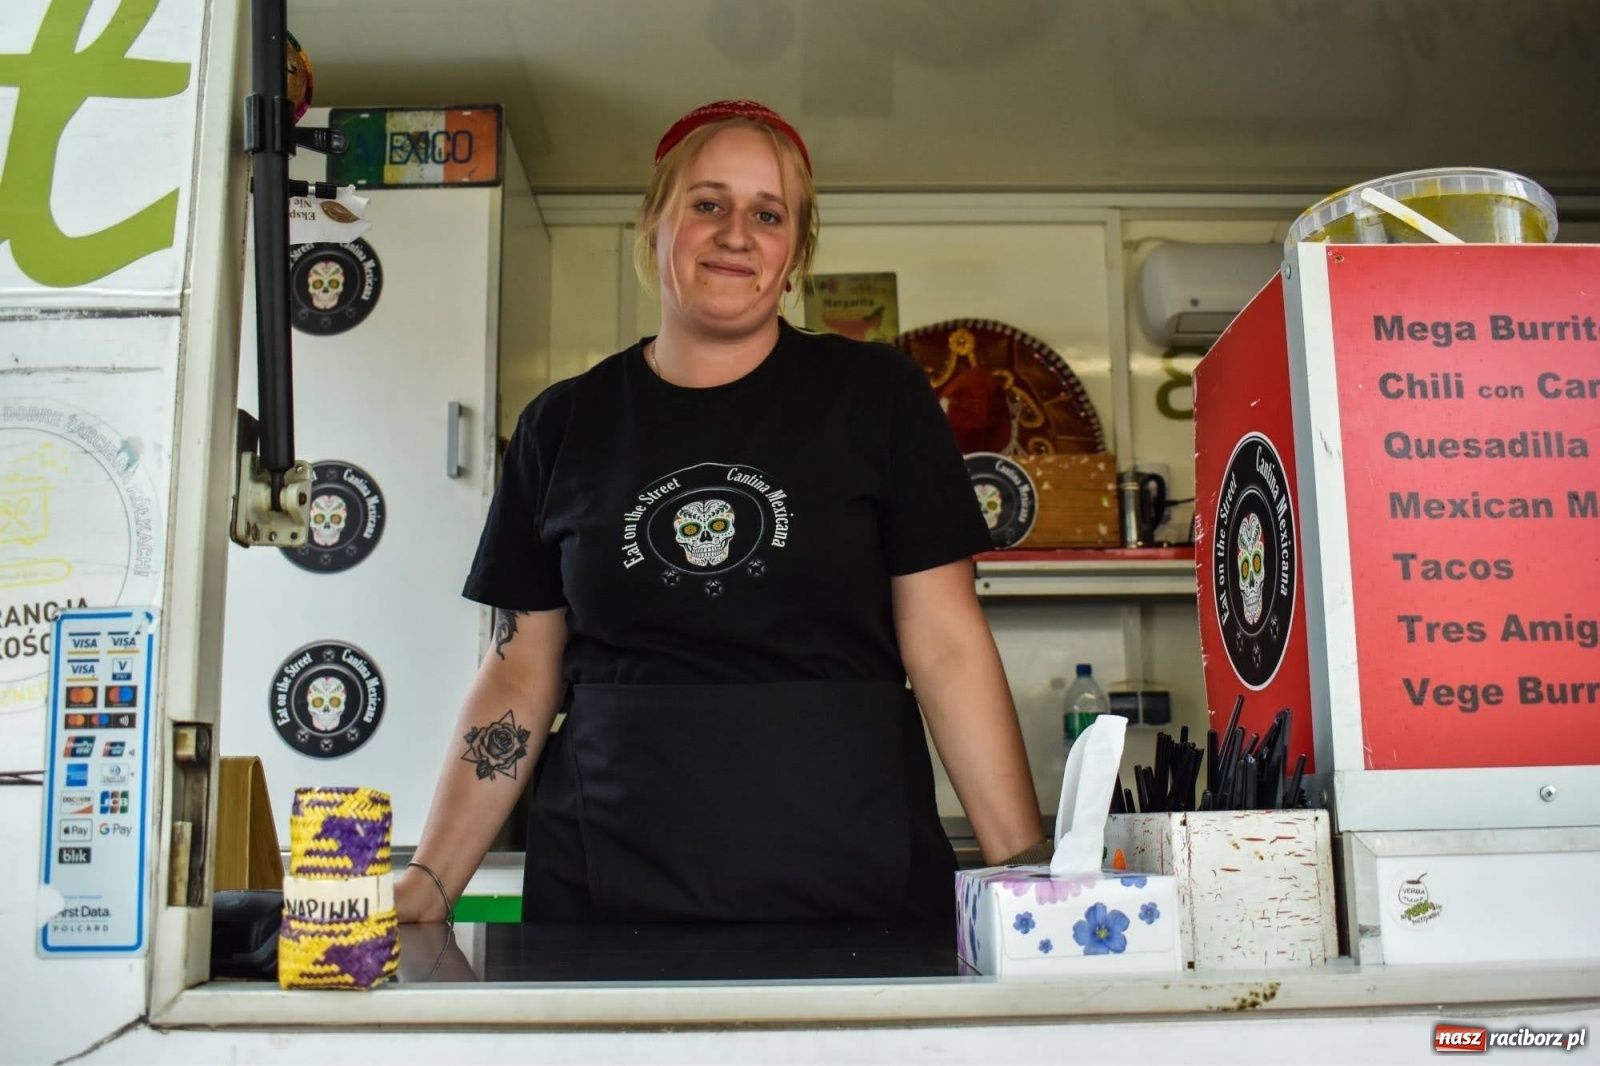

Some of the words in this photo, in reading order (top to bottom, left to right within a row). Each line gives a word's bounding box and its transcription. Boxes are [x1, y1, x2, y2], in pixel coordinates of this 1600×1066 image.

[1373, 315, 1477, 348] Mega
[1489, 314, 1600, 342] Burrit
[1378, 372, 1465, 400] Chili
[1478, 385, 1525, 399] con
[1384, 431, 1590, 460] Quesadilla
[343, 468, 371, 497] Cantina
[638, 477, 681, 505] Street
[726, 467, 770, 493] Cantina
[765, 489, 794, 548] Mexicana
[1220, 471, 1237, 525] Street
[1389, 491, 1553, 519] Mexican
[1567, 490, 1599, 519] M
[624, 505, 647, 522] the
[1256, 445, 1279, 502] Cantina
[1276, 493, 1291, 597] Mexicana
[623, 523, 637, 540] on
[1216, 528, 1226, 557] the
[621, 541, 645, 569] Eat
[1392, 552, 1515, 581] Tacos
[1218, 563, 1226, 586] on
[0, 627, 51, 660] OŚC
[72, 638, 98, 648] VISA
[112, 636, 137, 647] VISA
[1397, 614, 1487, 643] Tres
[1500, 612, 1599, 649] Amig
[72, 664, 95, 675] VISA
[284, 652, 313, 678] Street
[276, 677, 292, 693] the
[342, 648, 371, 679] Cantina
[363, 676, 382, 723] Mexicana
[1402, 677, 1505, 713] Vege
[1518, 676, 1600, 706] Burr
[277, 694, 287, 706] on
[276, 708, 290, 727] Eat
[72, 825, 88, 836] Pay
[113, 822, 133, 837] Pay
[63, 848, 87, 863] blik
[81, 905, 110, 917] Data
[286, 897, 369, 919] NAPIWKI
